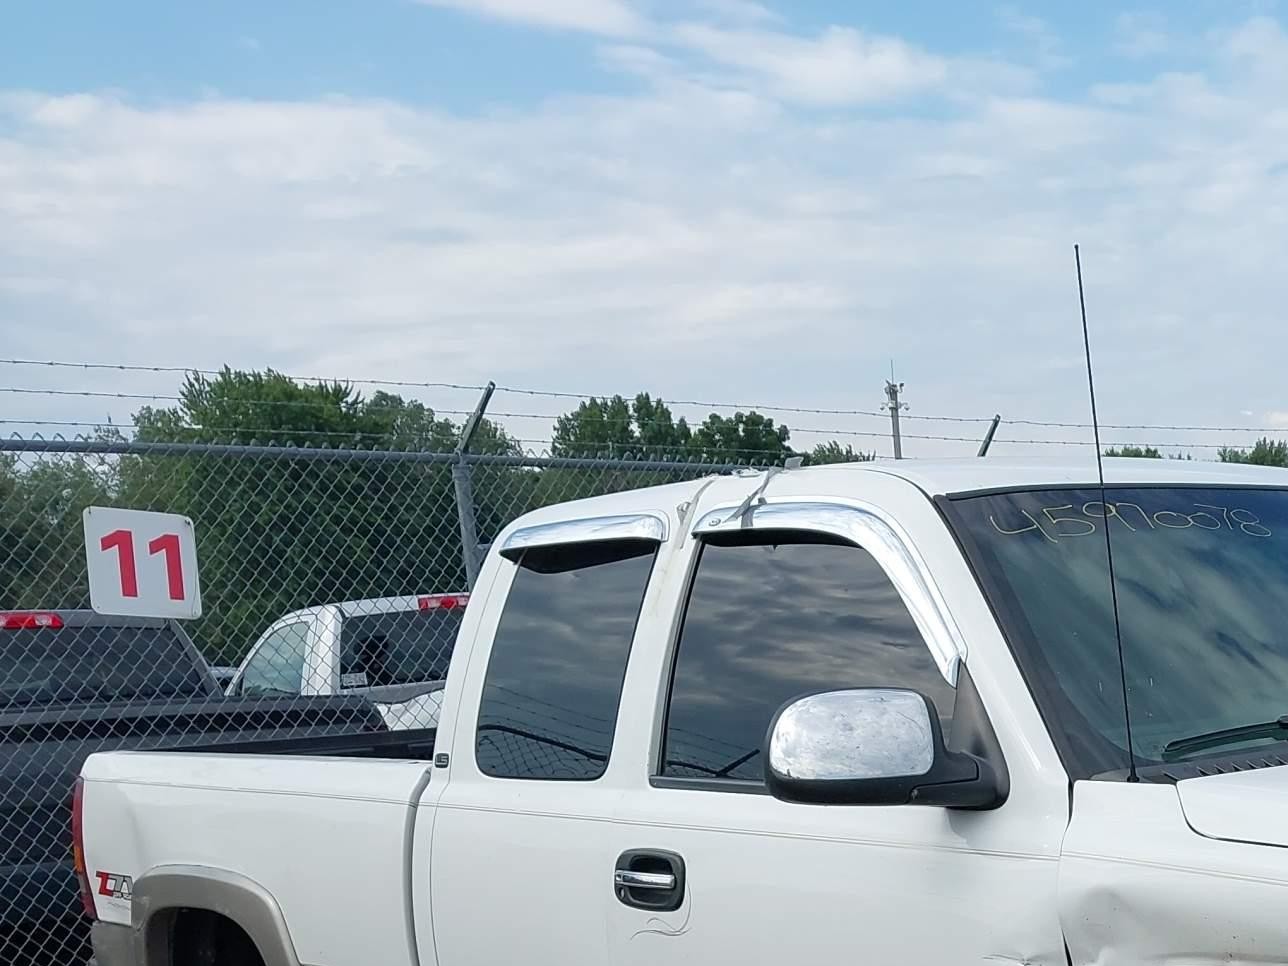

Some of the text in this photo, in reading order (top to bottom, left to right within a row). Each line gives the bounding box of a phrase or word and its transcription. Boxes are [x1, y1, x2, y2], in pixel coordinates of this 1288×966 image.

[989, 501, 1272, 543] 45970078
[101, 529, 185, 601] 11
[435, 755, 448, 766] LS
